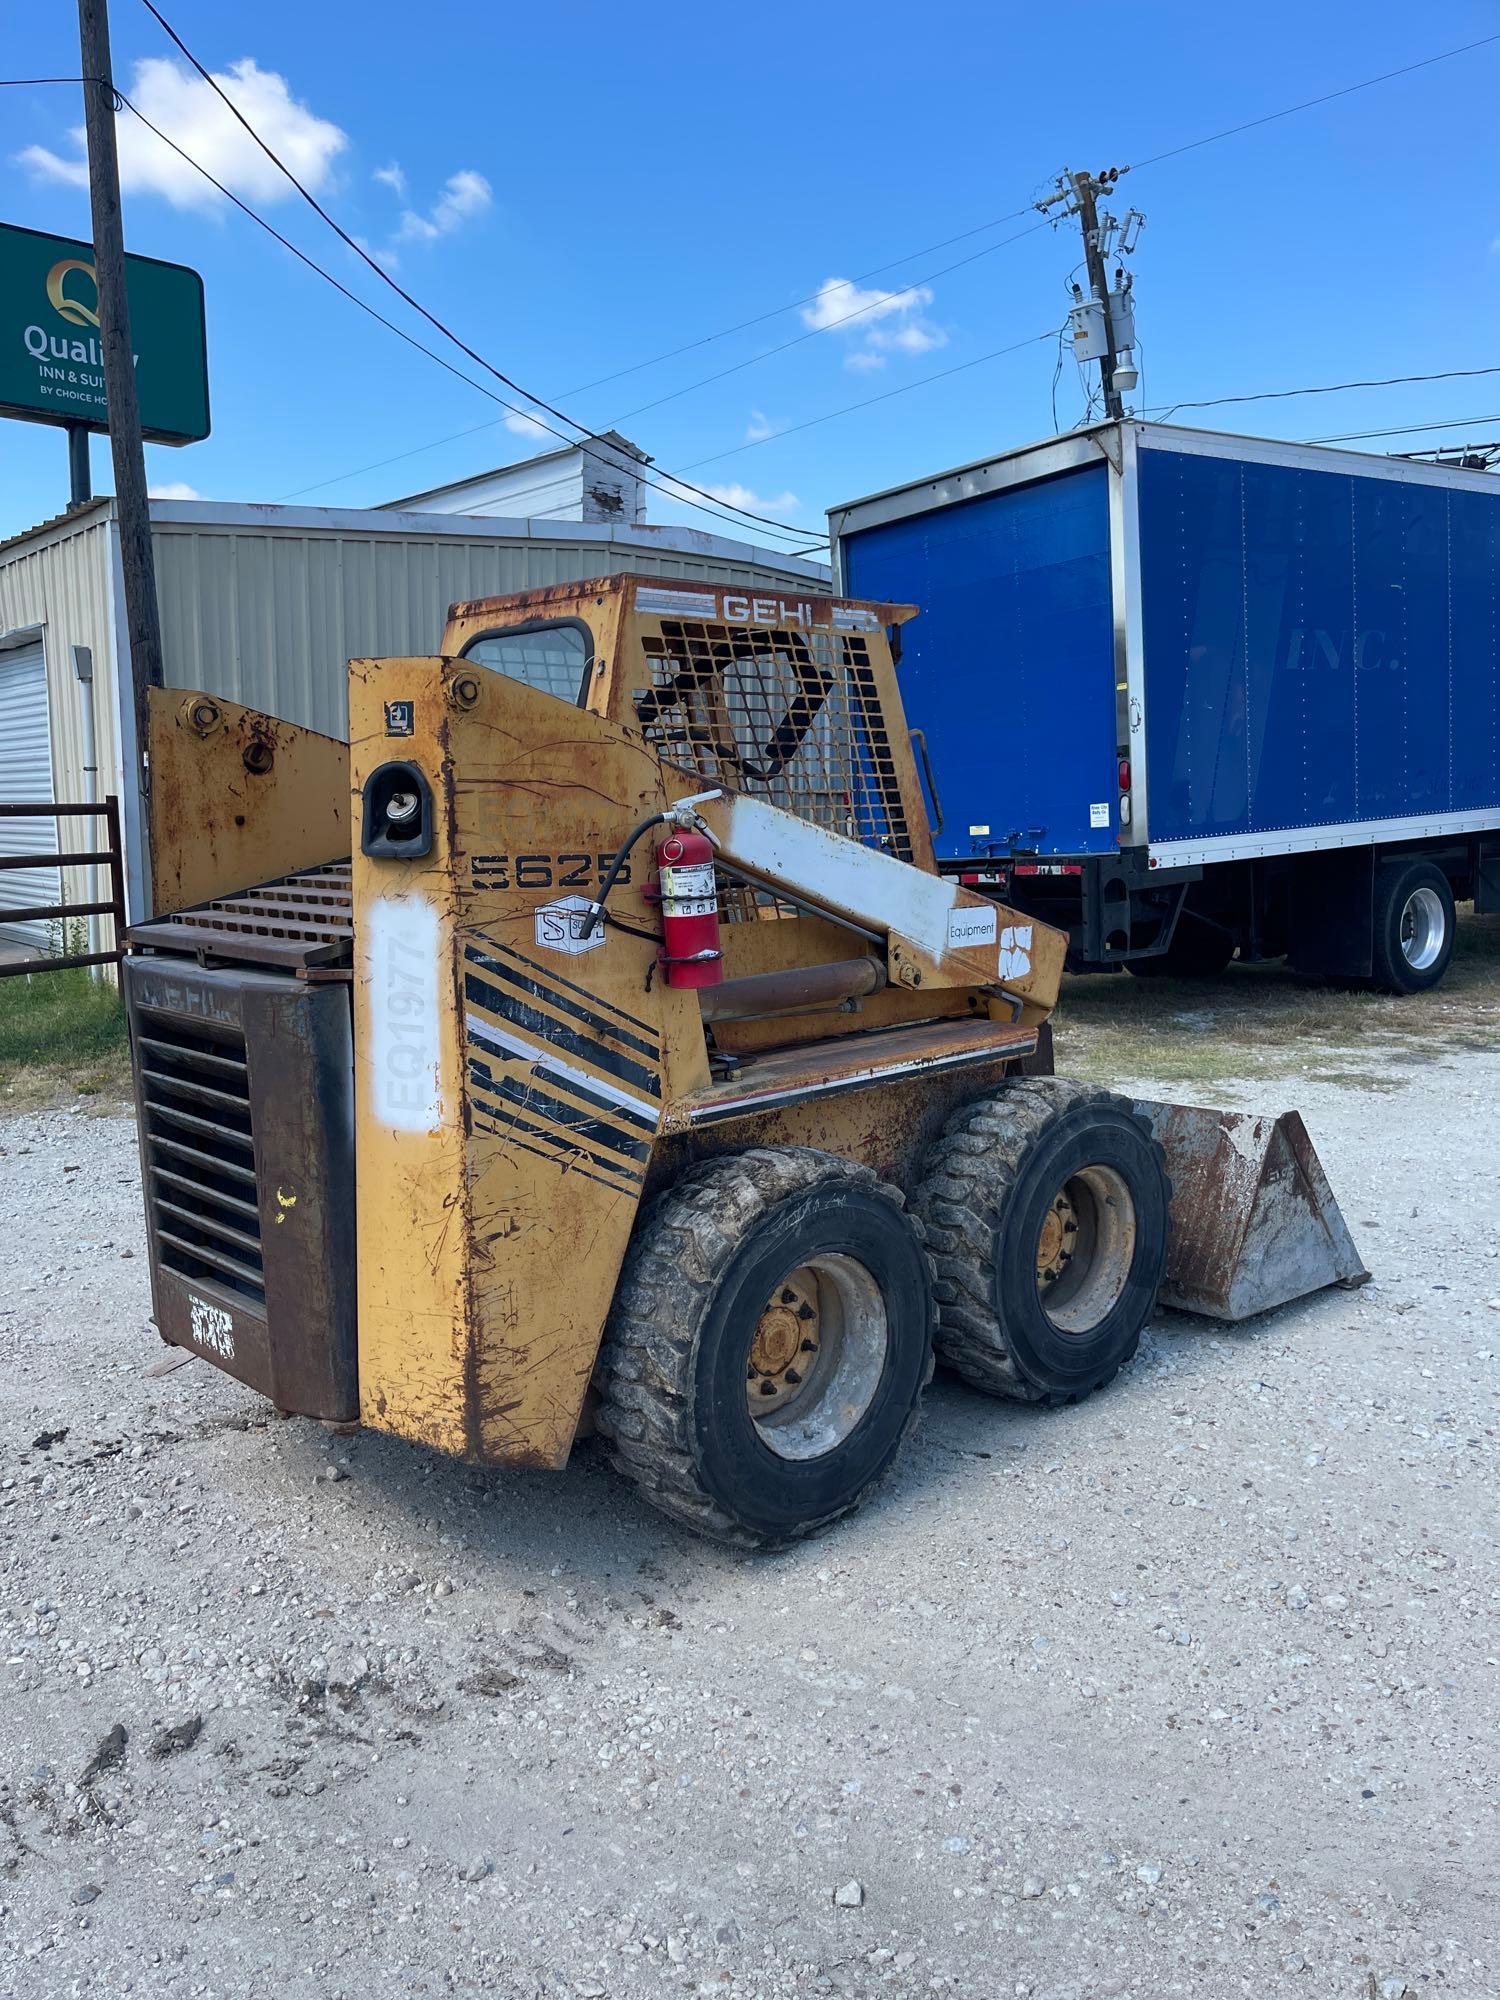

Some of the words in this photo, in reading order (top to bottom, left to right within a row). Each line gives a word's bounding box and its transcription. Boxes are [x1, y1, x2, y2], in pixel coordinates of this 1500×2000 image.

[24, 325, 139, 367] Quali
[40, 365, 65, 381] INN
[68, 371, 78, 384] &
[80, 373, 106, 388] SUI
[40, 385, 53, 395] BY
[56, 388, 92, 403] CHOICE
[95, 396, 108, 406] HO
[723, 595, 829, 629] GEHL
[1284, 628, 1400, 671] INC.
[471, 853, 632, 889] 5625
[950, 923, 995, 939] Equipment
[387, 937, 427, 1112] EQ1977
